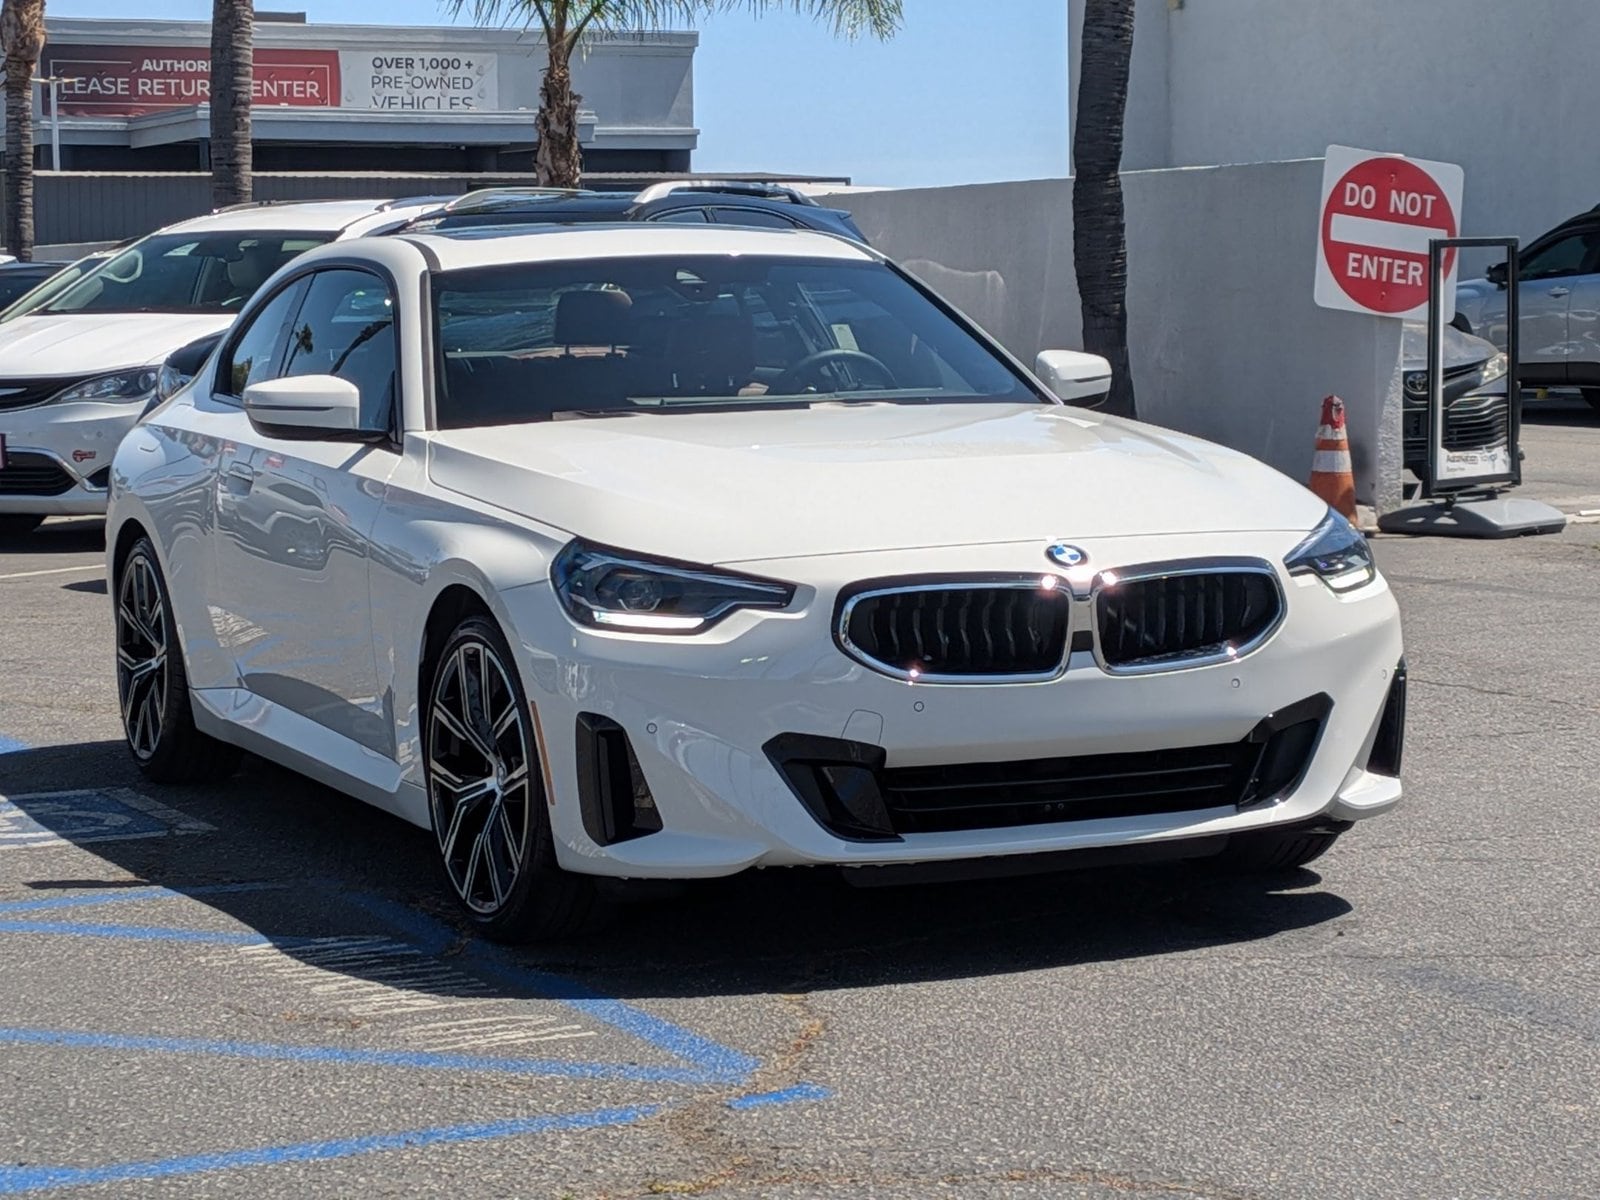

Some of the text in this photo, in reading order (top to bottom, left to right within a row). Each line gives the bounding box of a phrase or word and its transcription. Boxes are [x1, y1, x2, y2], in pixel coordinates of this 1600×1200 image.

[141, 59, 211, 72] AUTHORI
[372, 57, 415, 69] OVER
[418, 58, 461, 71] 1,000
[61, 77, 320, 98] LEASE RETUR ENTER
[371, 75, 474, 90] PRE-OWNED
[1344, 182, 1437, 218] DO NOT
[1347, 252, 1424, 286] ENTER
